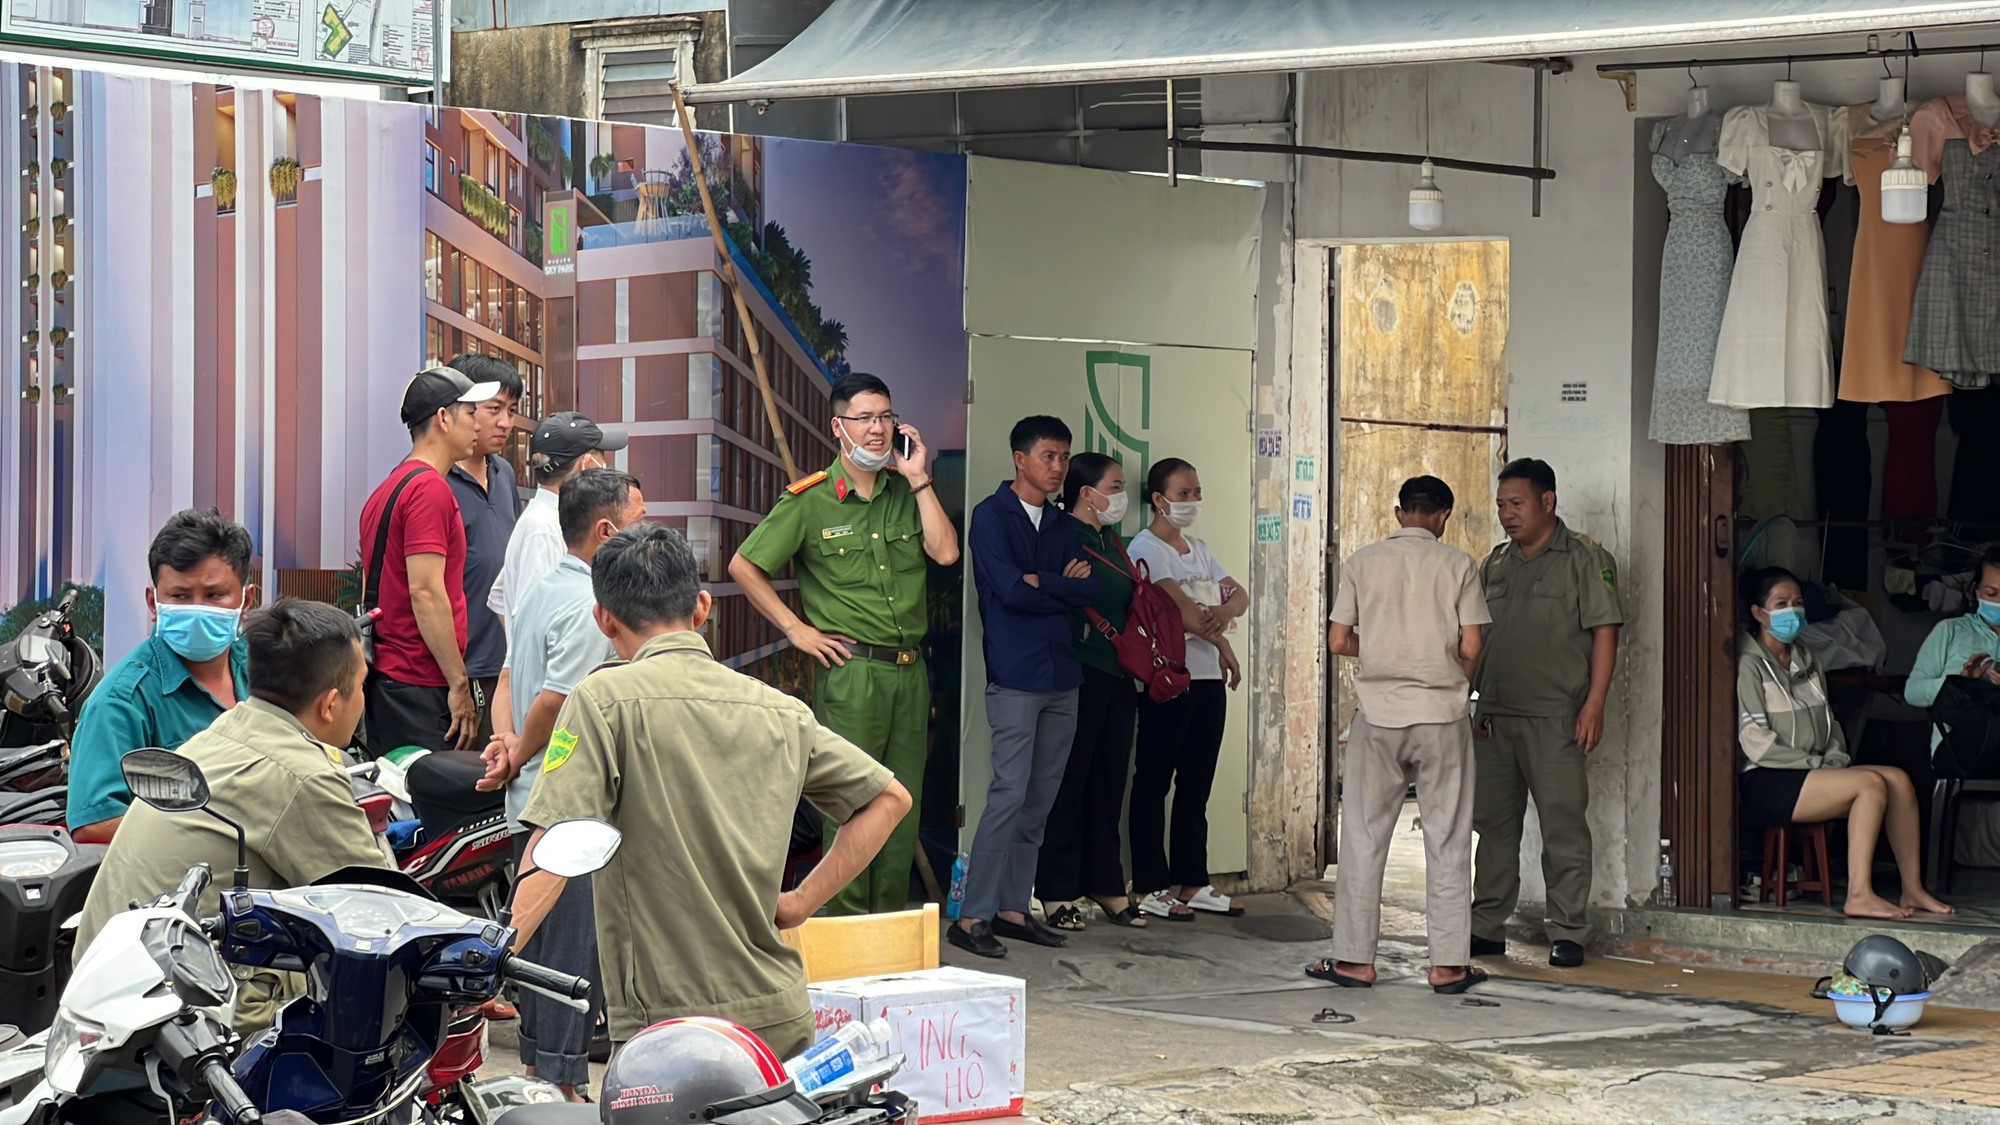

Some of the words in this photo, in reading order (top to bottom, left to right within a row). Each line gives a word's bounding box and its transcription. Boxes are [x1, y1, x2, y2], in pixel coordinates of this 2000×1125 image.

[545, 266, 557, 275] SKY
[557, 264, 574, 274] PARK
[944, 1049, 984, 1108] HỘ
[620, 1084, 659, 1099] HONDA
[637, 1093, 674, 1106] MINH
